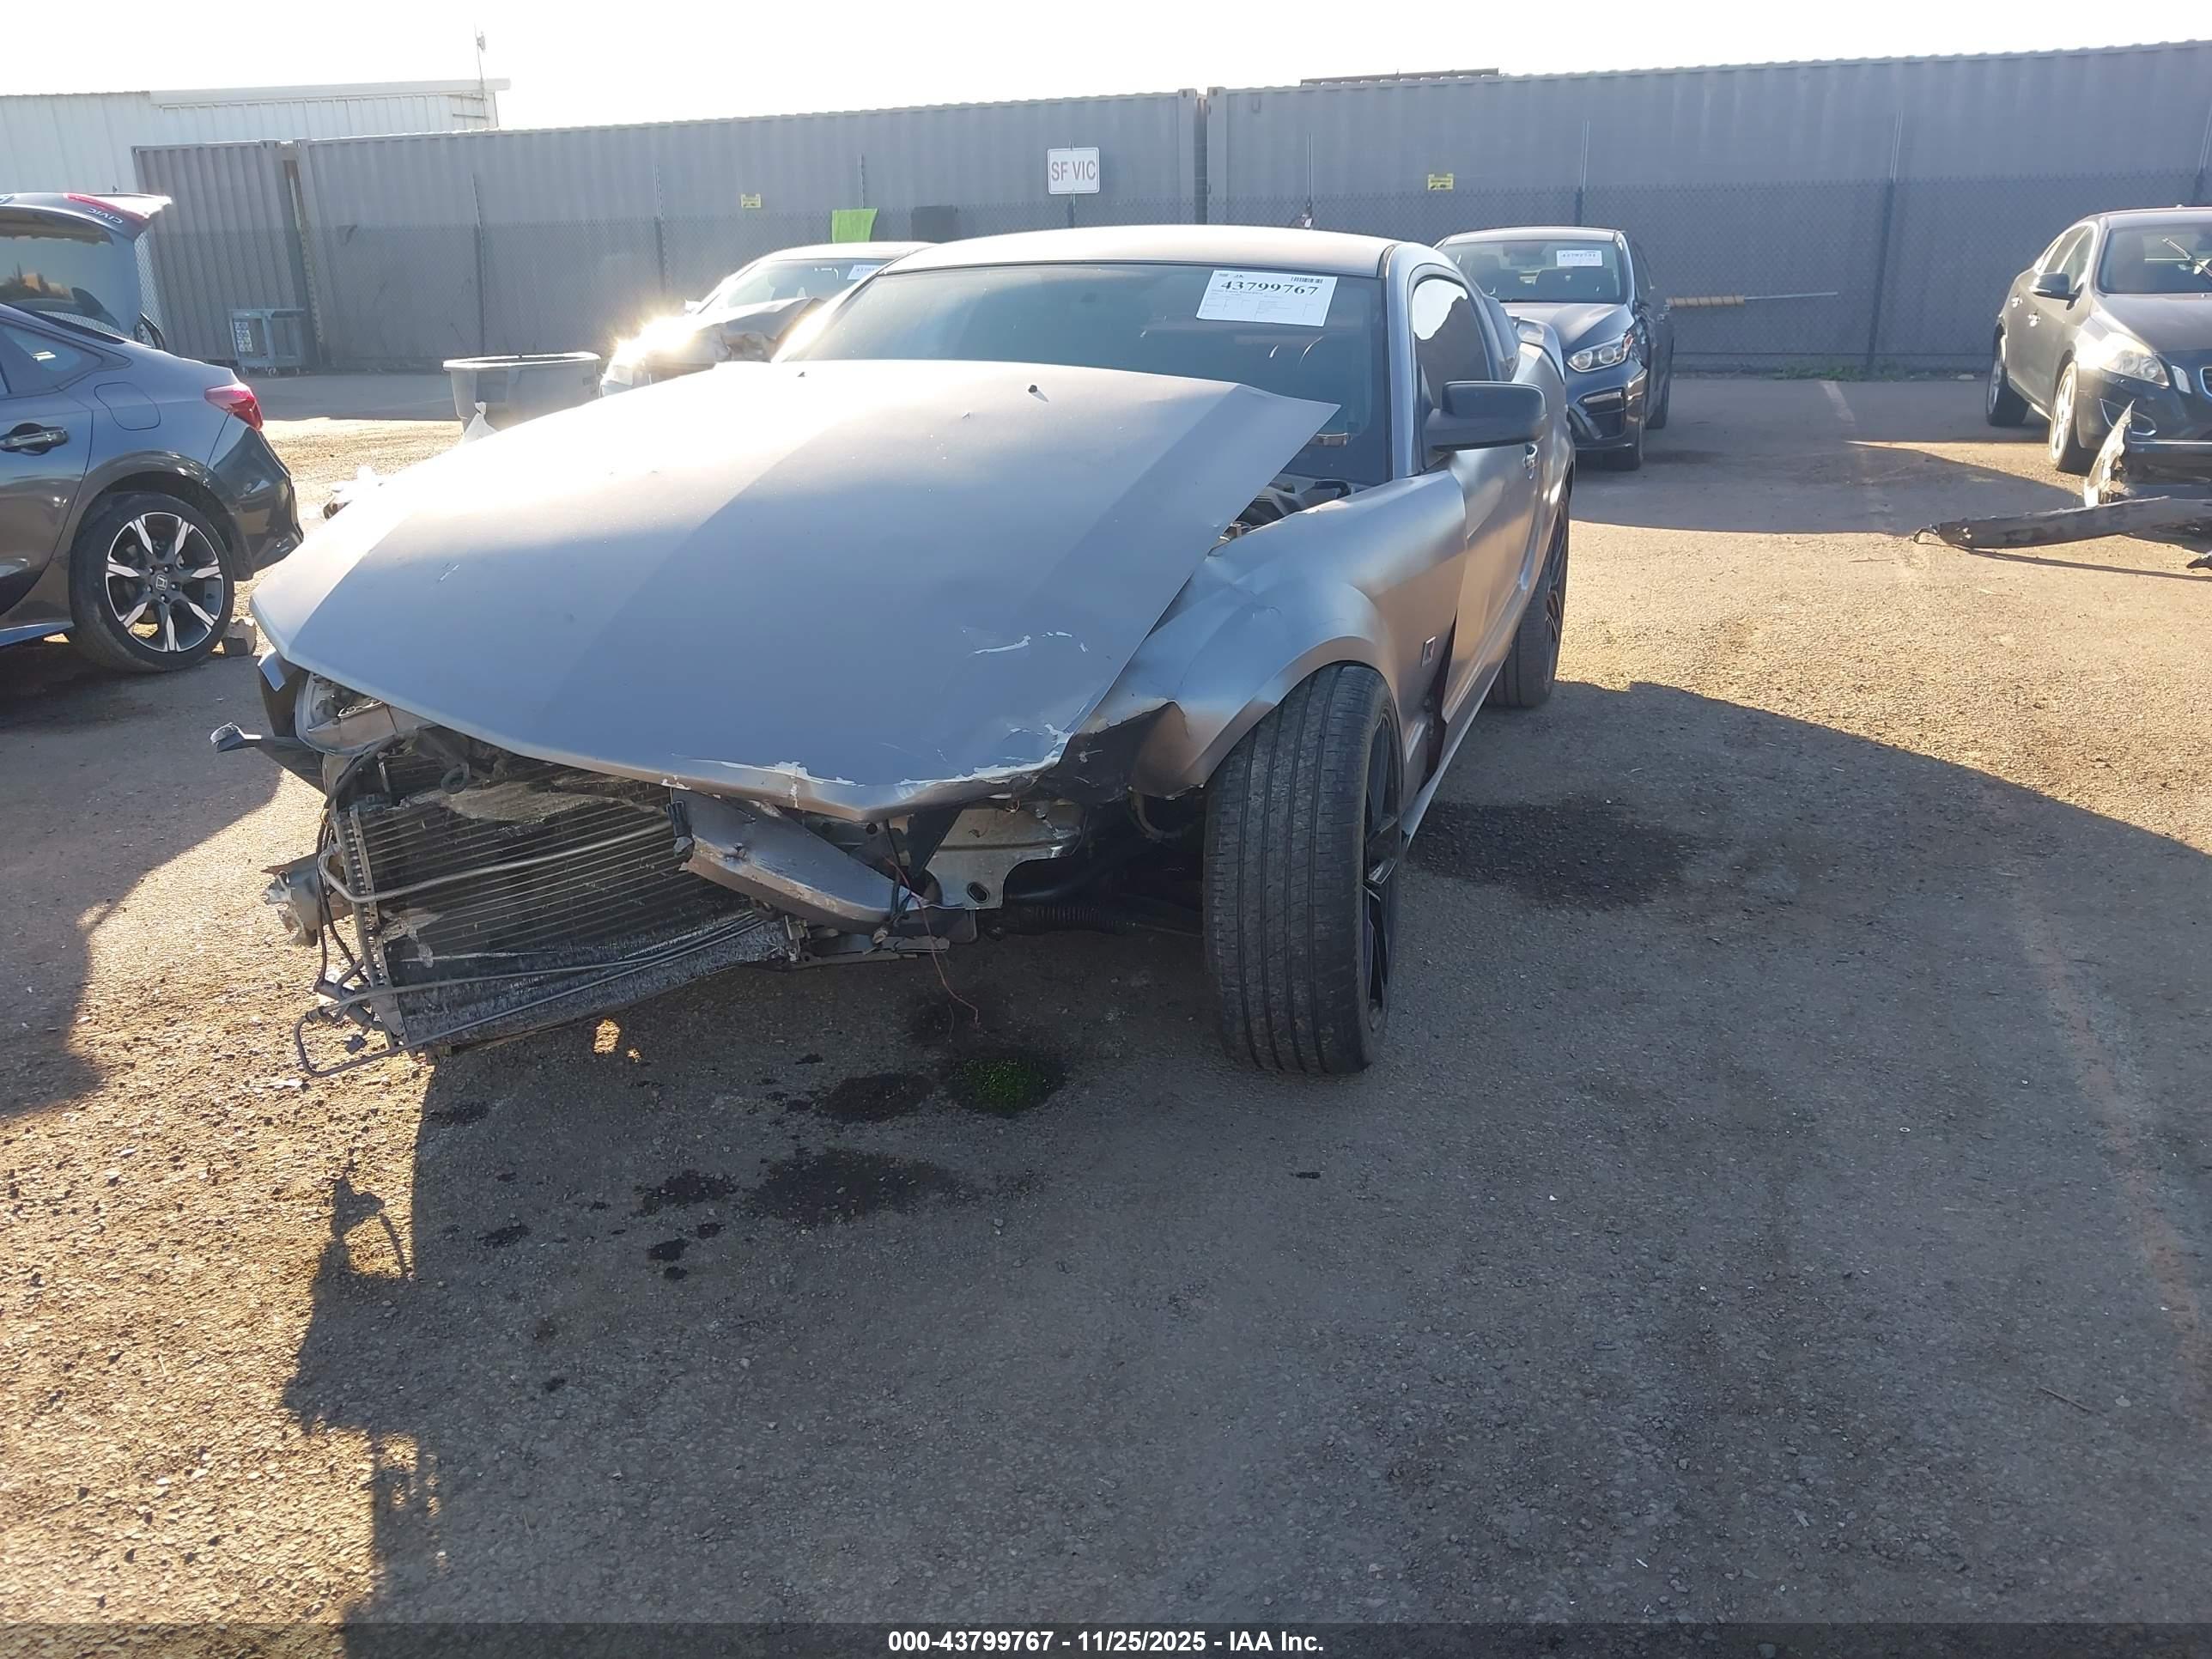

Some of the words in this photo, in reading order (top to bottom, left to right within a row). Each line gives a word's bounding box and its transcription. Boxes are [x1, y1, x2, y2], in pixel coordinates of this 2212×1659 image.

[1051, 161, 1068, 181] SF
[1073, 160, 1096, 180] VIC
[87, 207, 124, 224] CIVIC
[1220, 280, 1319, 296] 43799767
